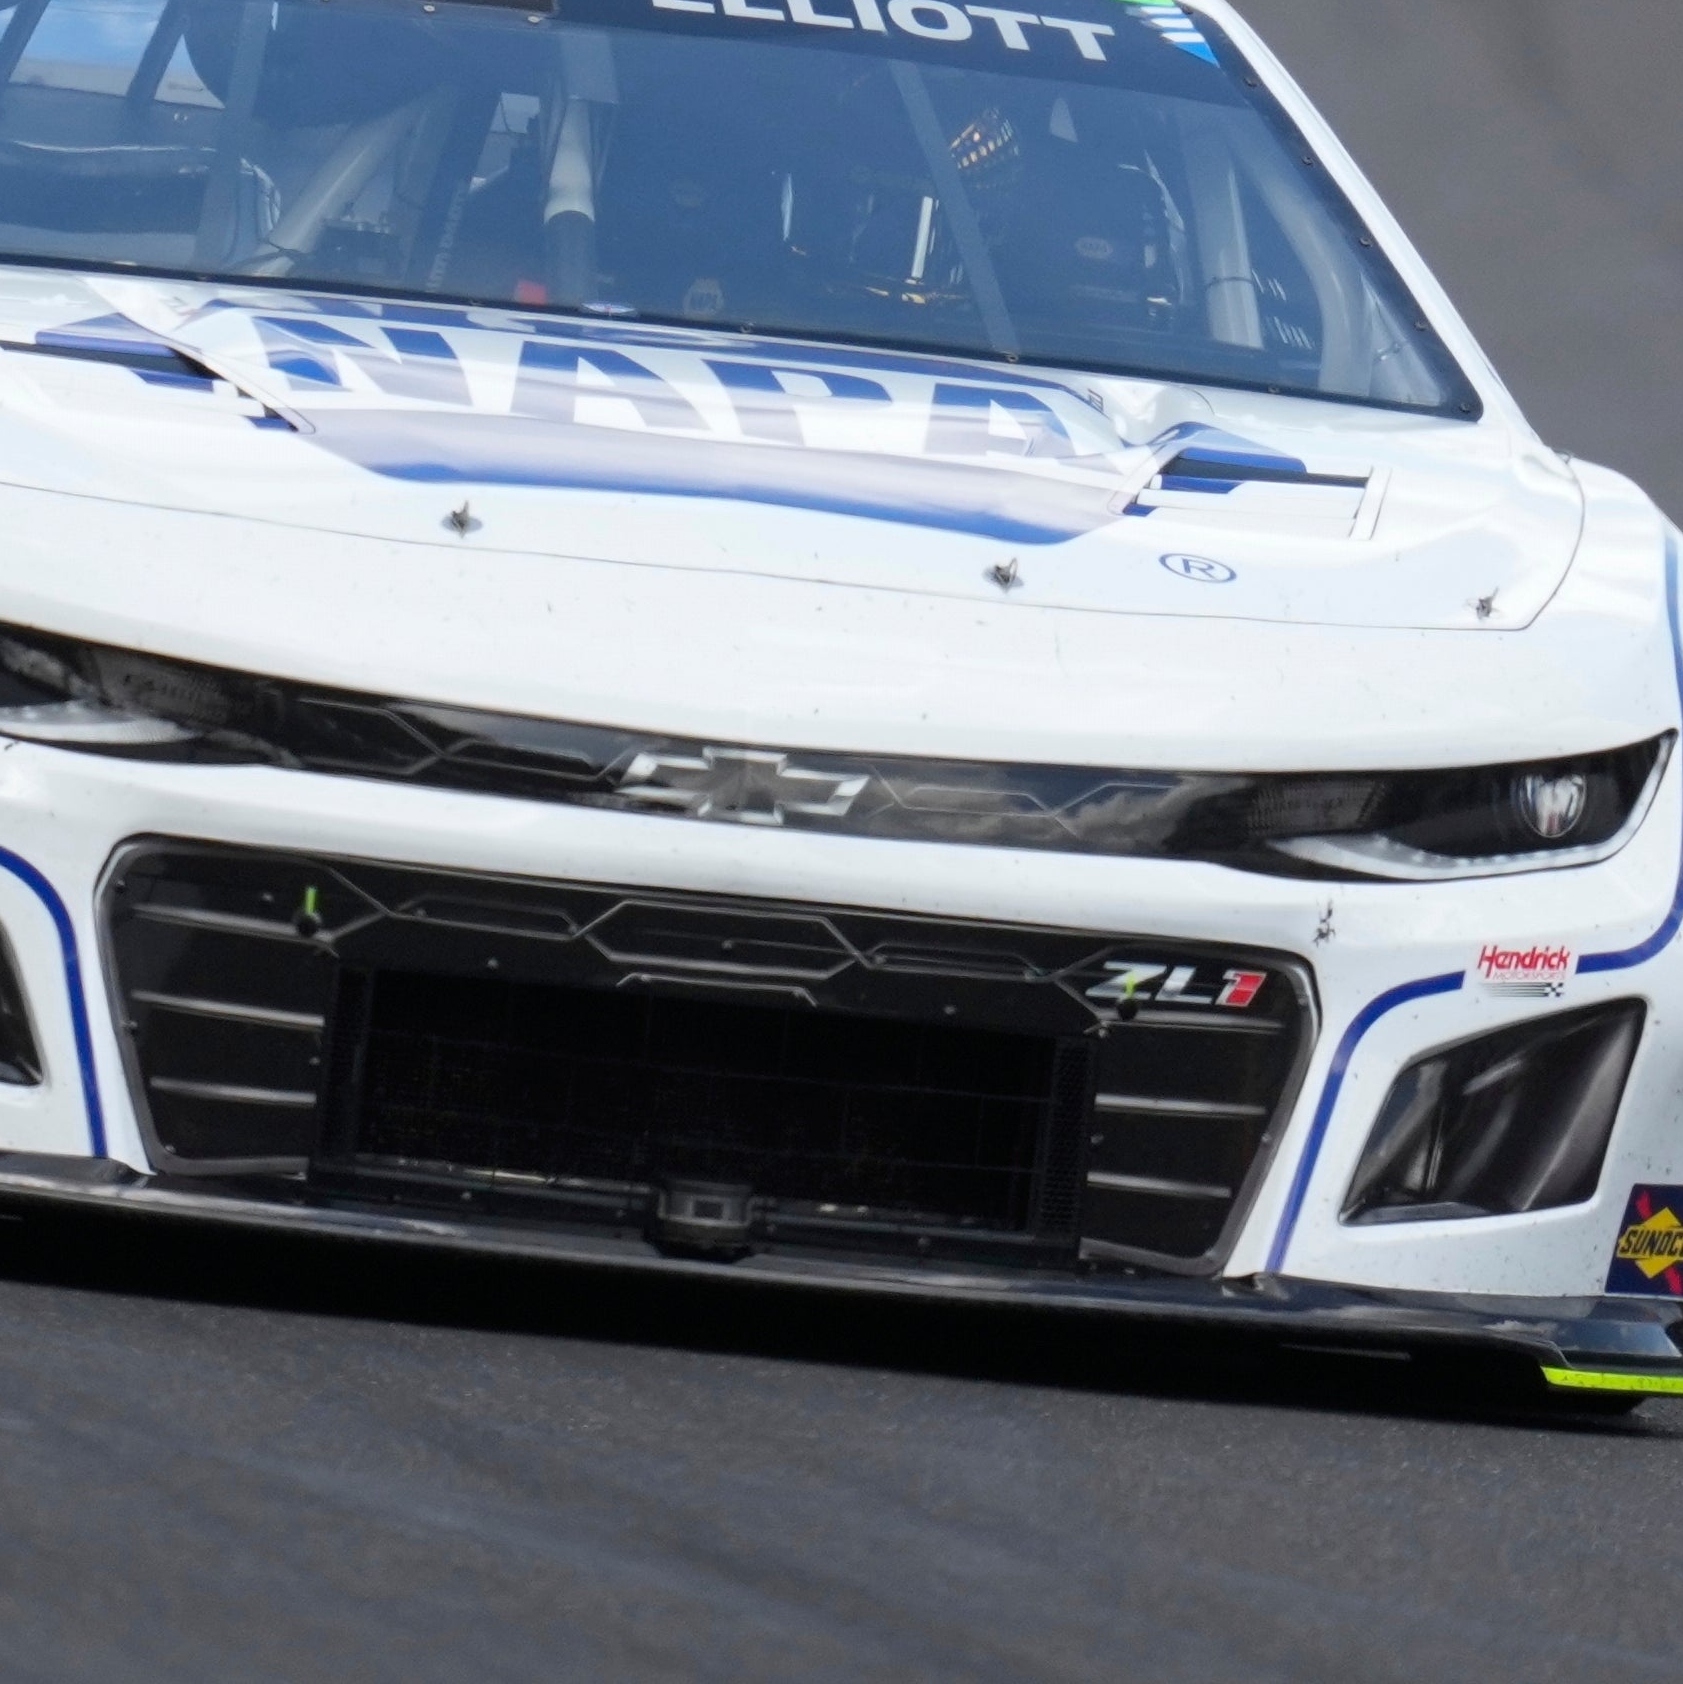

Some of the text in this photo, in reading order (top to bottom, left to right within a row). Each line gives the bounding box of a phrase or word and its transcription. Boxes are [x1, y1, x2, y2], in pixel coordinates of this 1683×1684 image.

[250, 315, 1082, 459] NAPA
[1085, 960, 1267, 1007] ZL1
[1477, 945, 1570, 978] Hendrick
